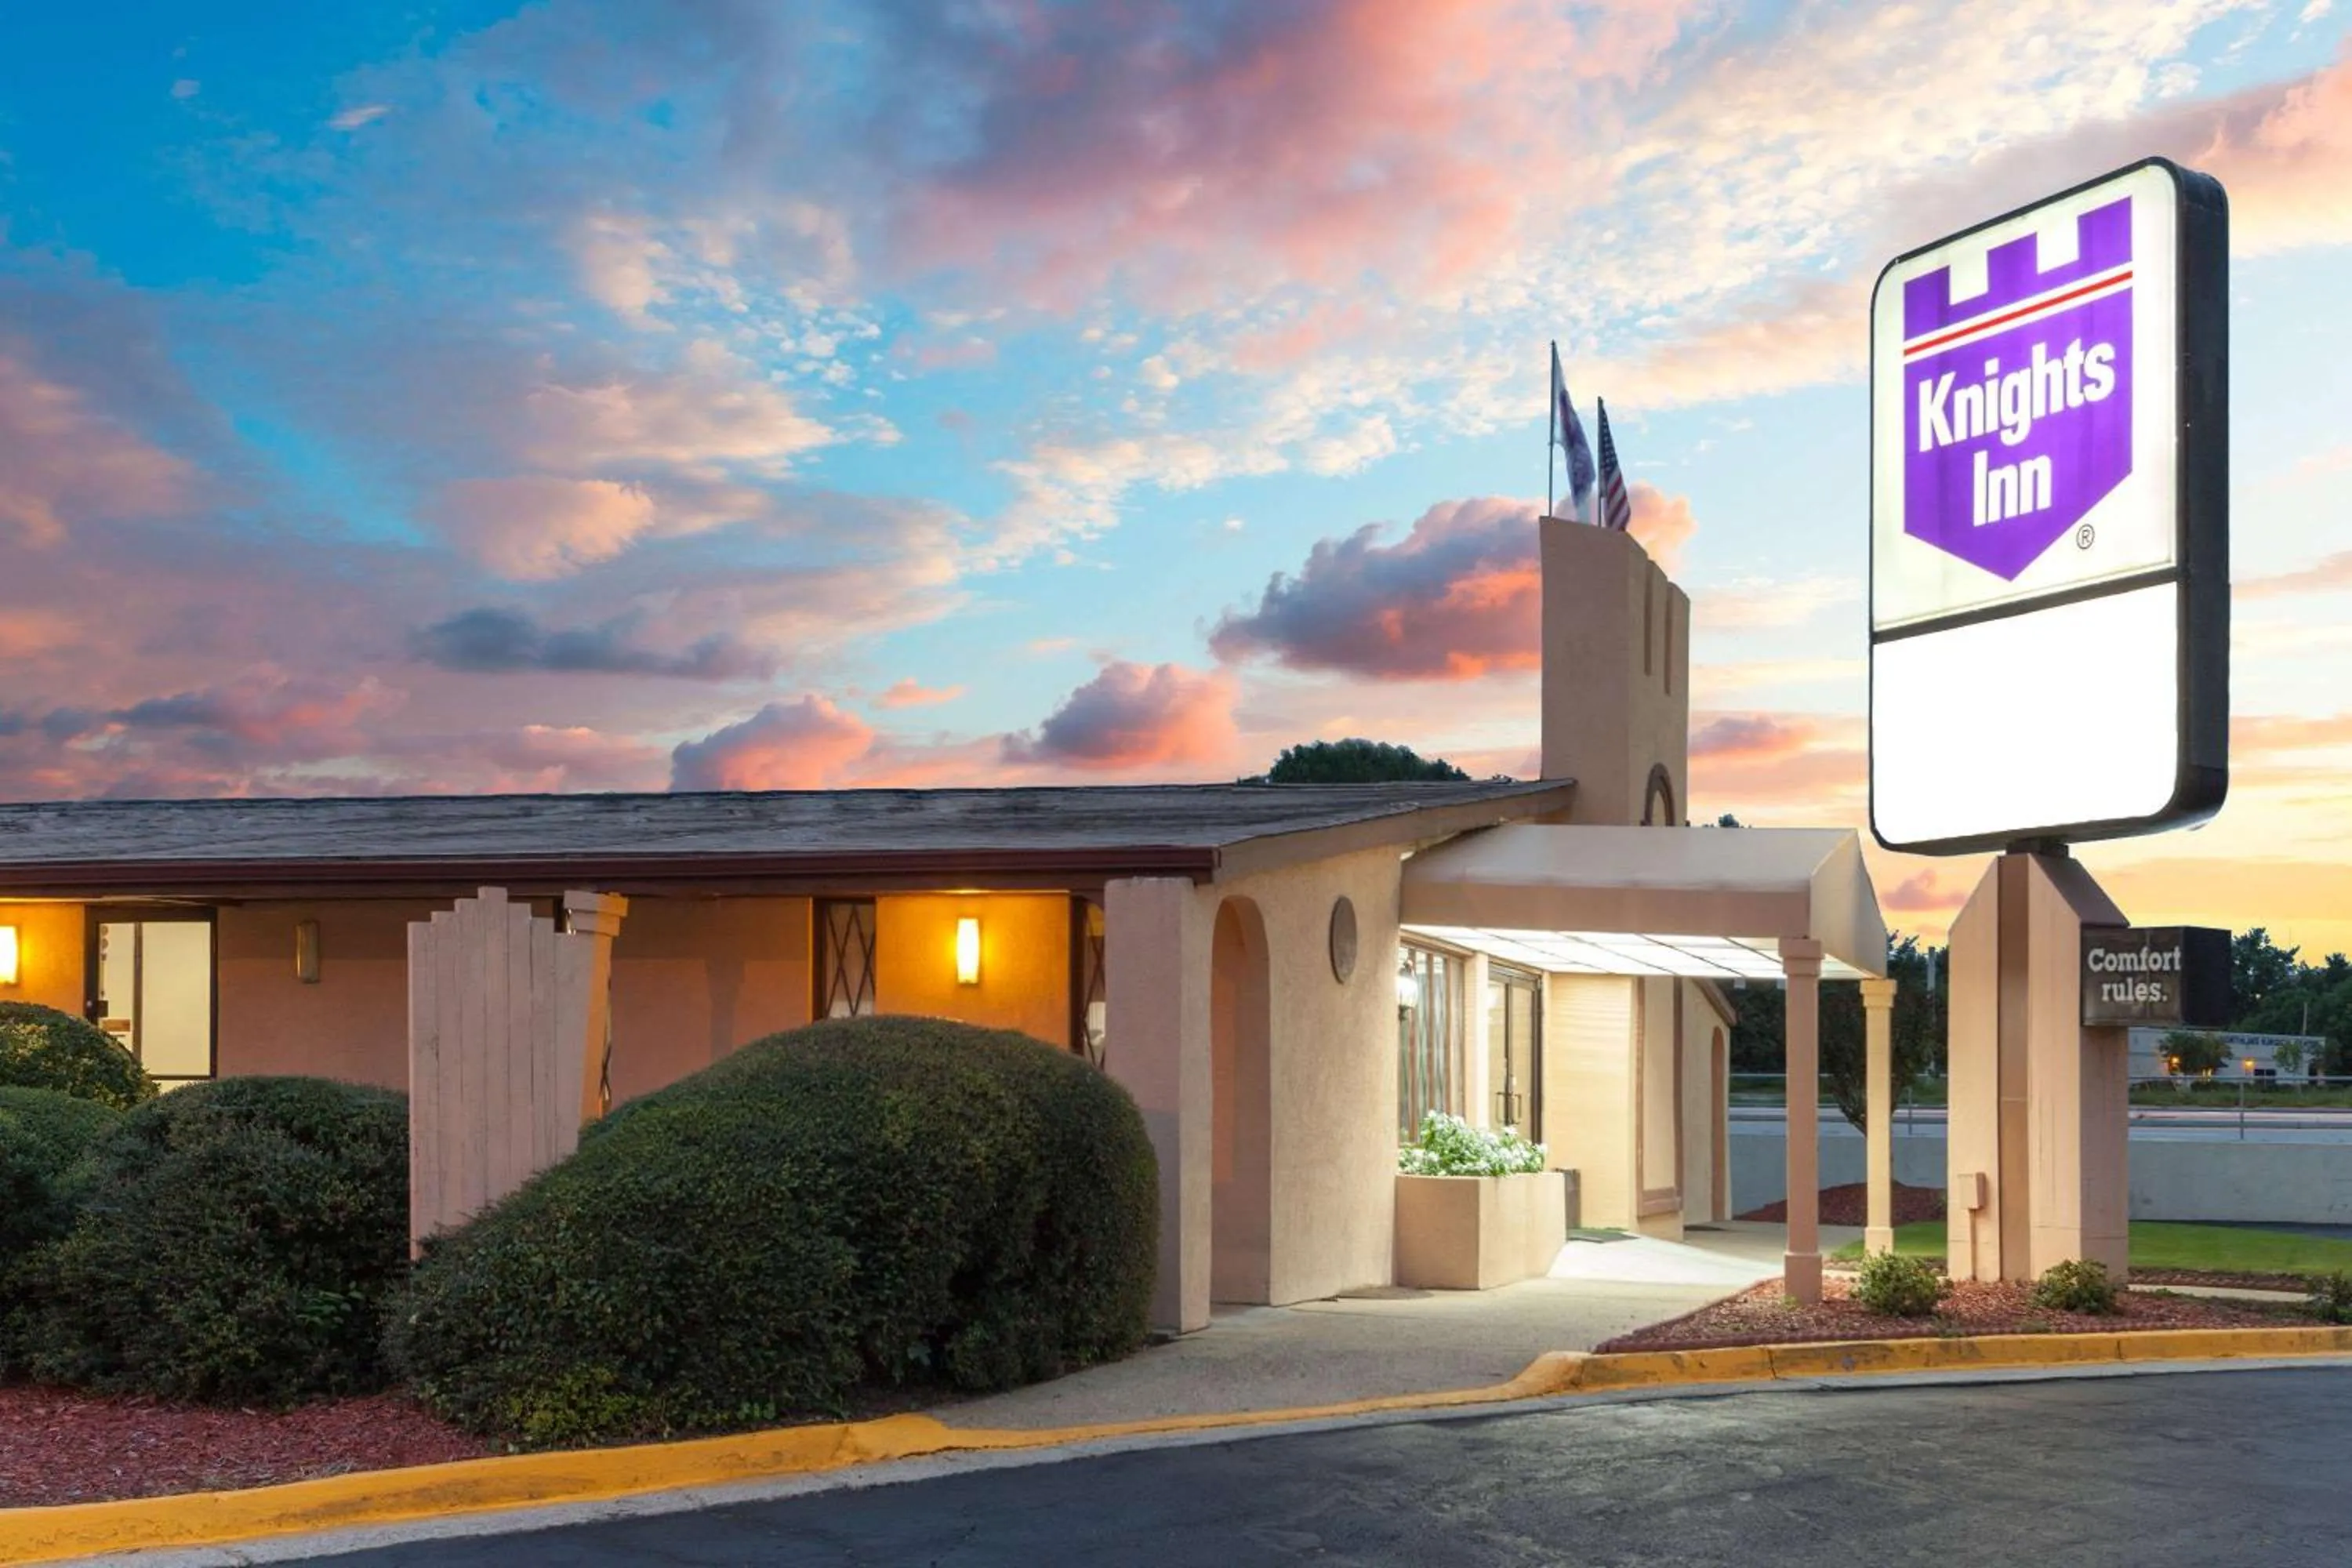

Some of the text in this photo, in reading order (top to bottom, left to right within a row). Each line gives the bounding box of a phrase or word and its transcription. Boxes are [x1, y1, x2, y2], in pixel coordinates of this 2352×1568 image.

[1918, 337, 2115, 452] Knights
[1973, 449, 2052, 527] Inn
[2088, 946, 2181, 972] Comfort
[2101, 978, 2168, 1002] rules.
